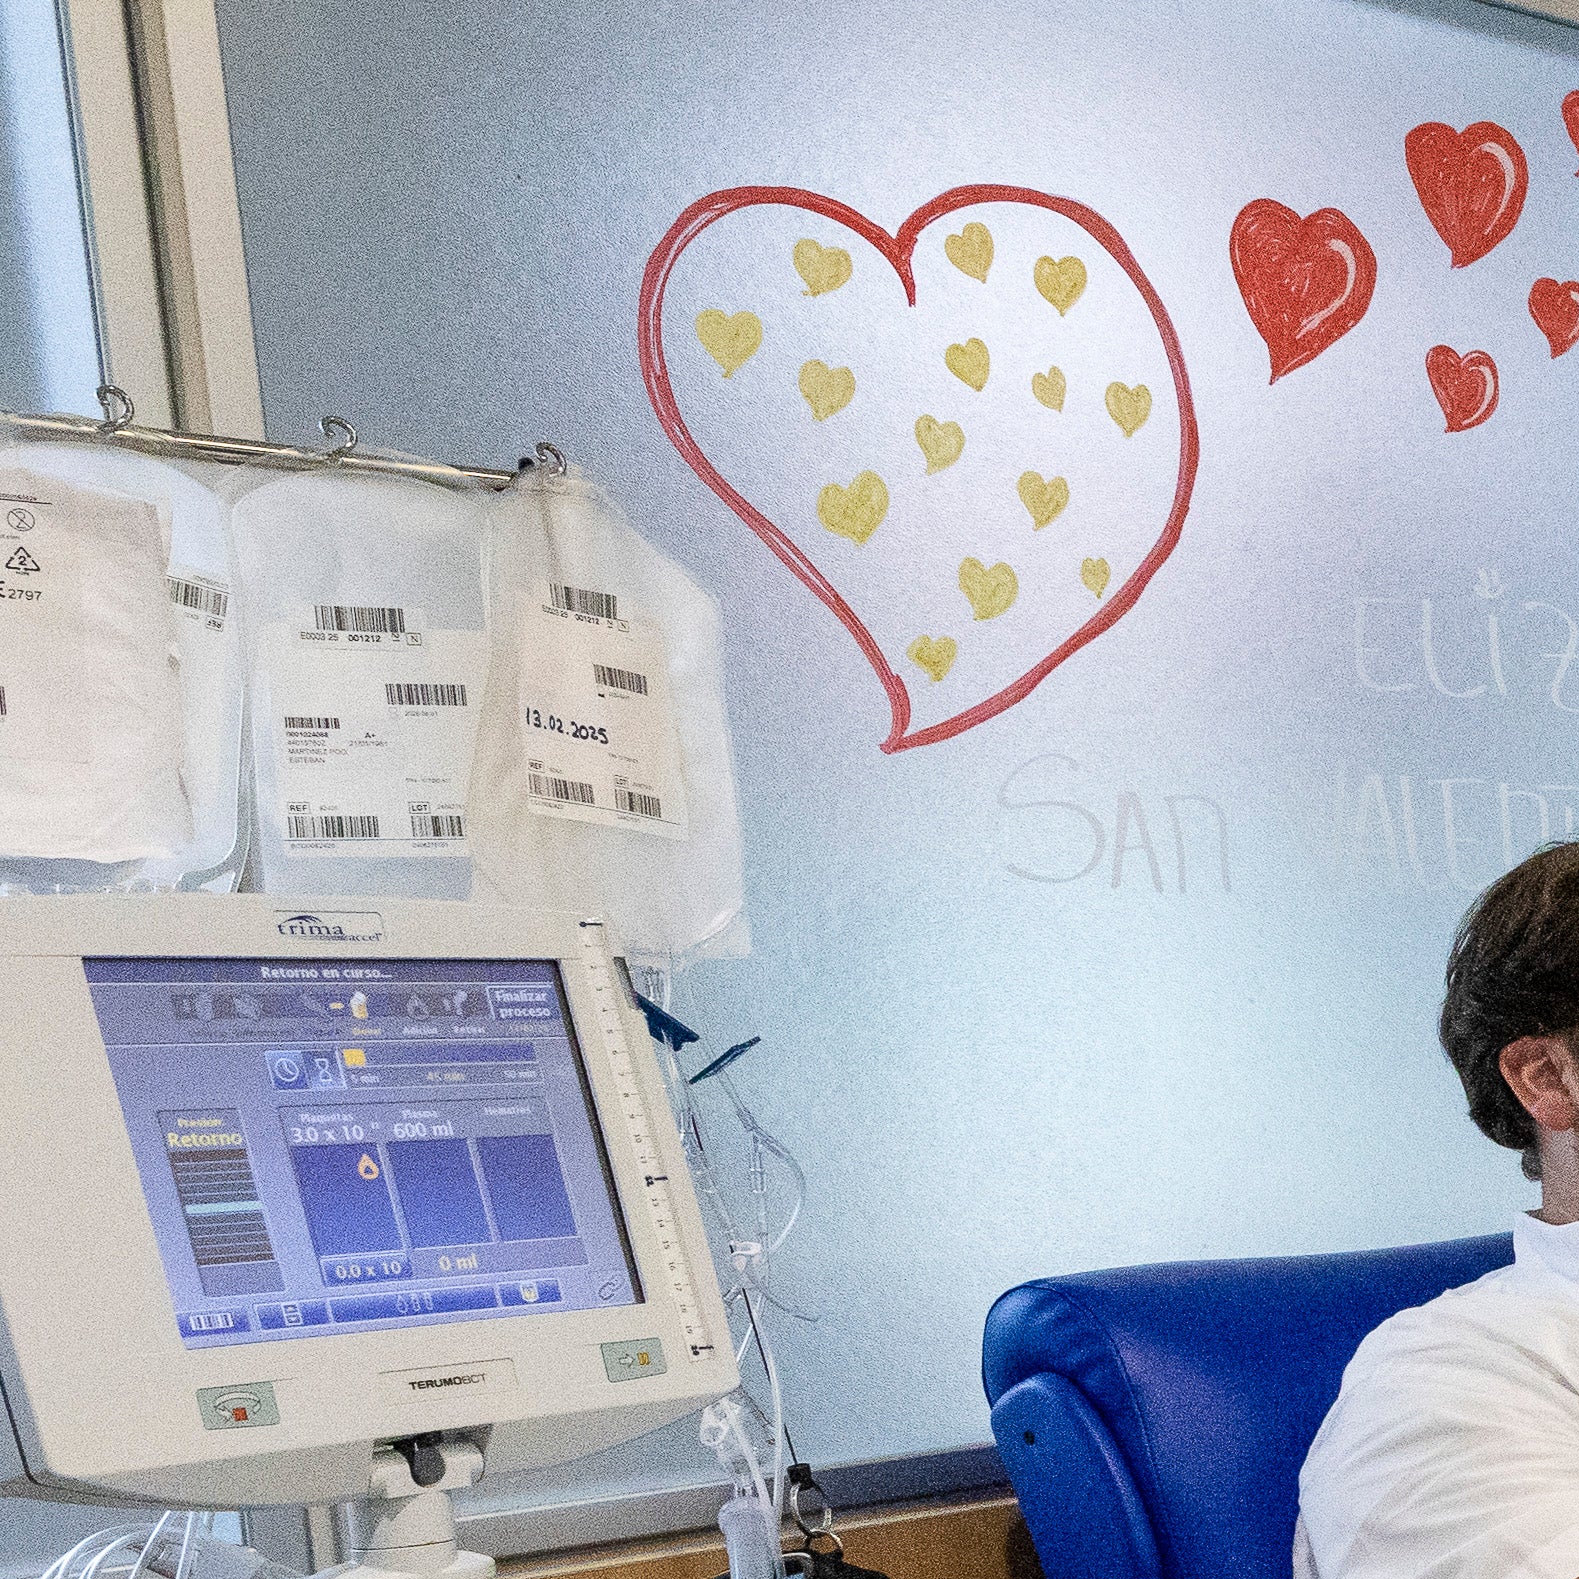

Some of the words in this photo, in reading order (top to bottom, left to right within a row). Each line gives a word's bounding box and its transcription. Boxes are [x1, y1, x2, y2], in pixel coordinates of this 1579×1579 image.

[8, 588, 43, 600] 2797
[348, 634, 382, 643] 001212
[525, 706, 610, 745] 13.02.2025
[289, 804, 308, 812] REF
[411, 803, 428, 812] LOT
[277, 916, 345, 938] trima
[261, 966, 319, 981] Retorno
[322, 969, 341, 980] en
[493, 989, 549, 1004] Finalizar
[499, 1005, 552, 1021] proceso
[300, 1110, 355, 1124] Plaquetas
[292, 1126, 322, 1143] 3.0
[325, 1130, 338, 1142] x
[342, 1126, 365, 1142] 10
[393, 1122, 428, 1140] 600
[432, 1120, 454, 1138] ml
[166, 1130, 243, 1148] Retorno
[335, 1262, 362, 1280] 0.0
[365, 1265, 375, 1278] x
[381, 1259, 401, 1277] 10
[437, 1254, 453, 1271] 0
[455, 1252, 479, 1271] ml
